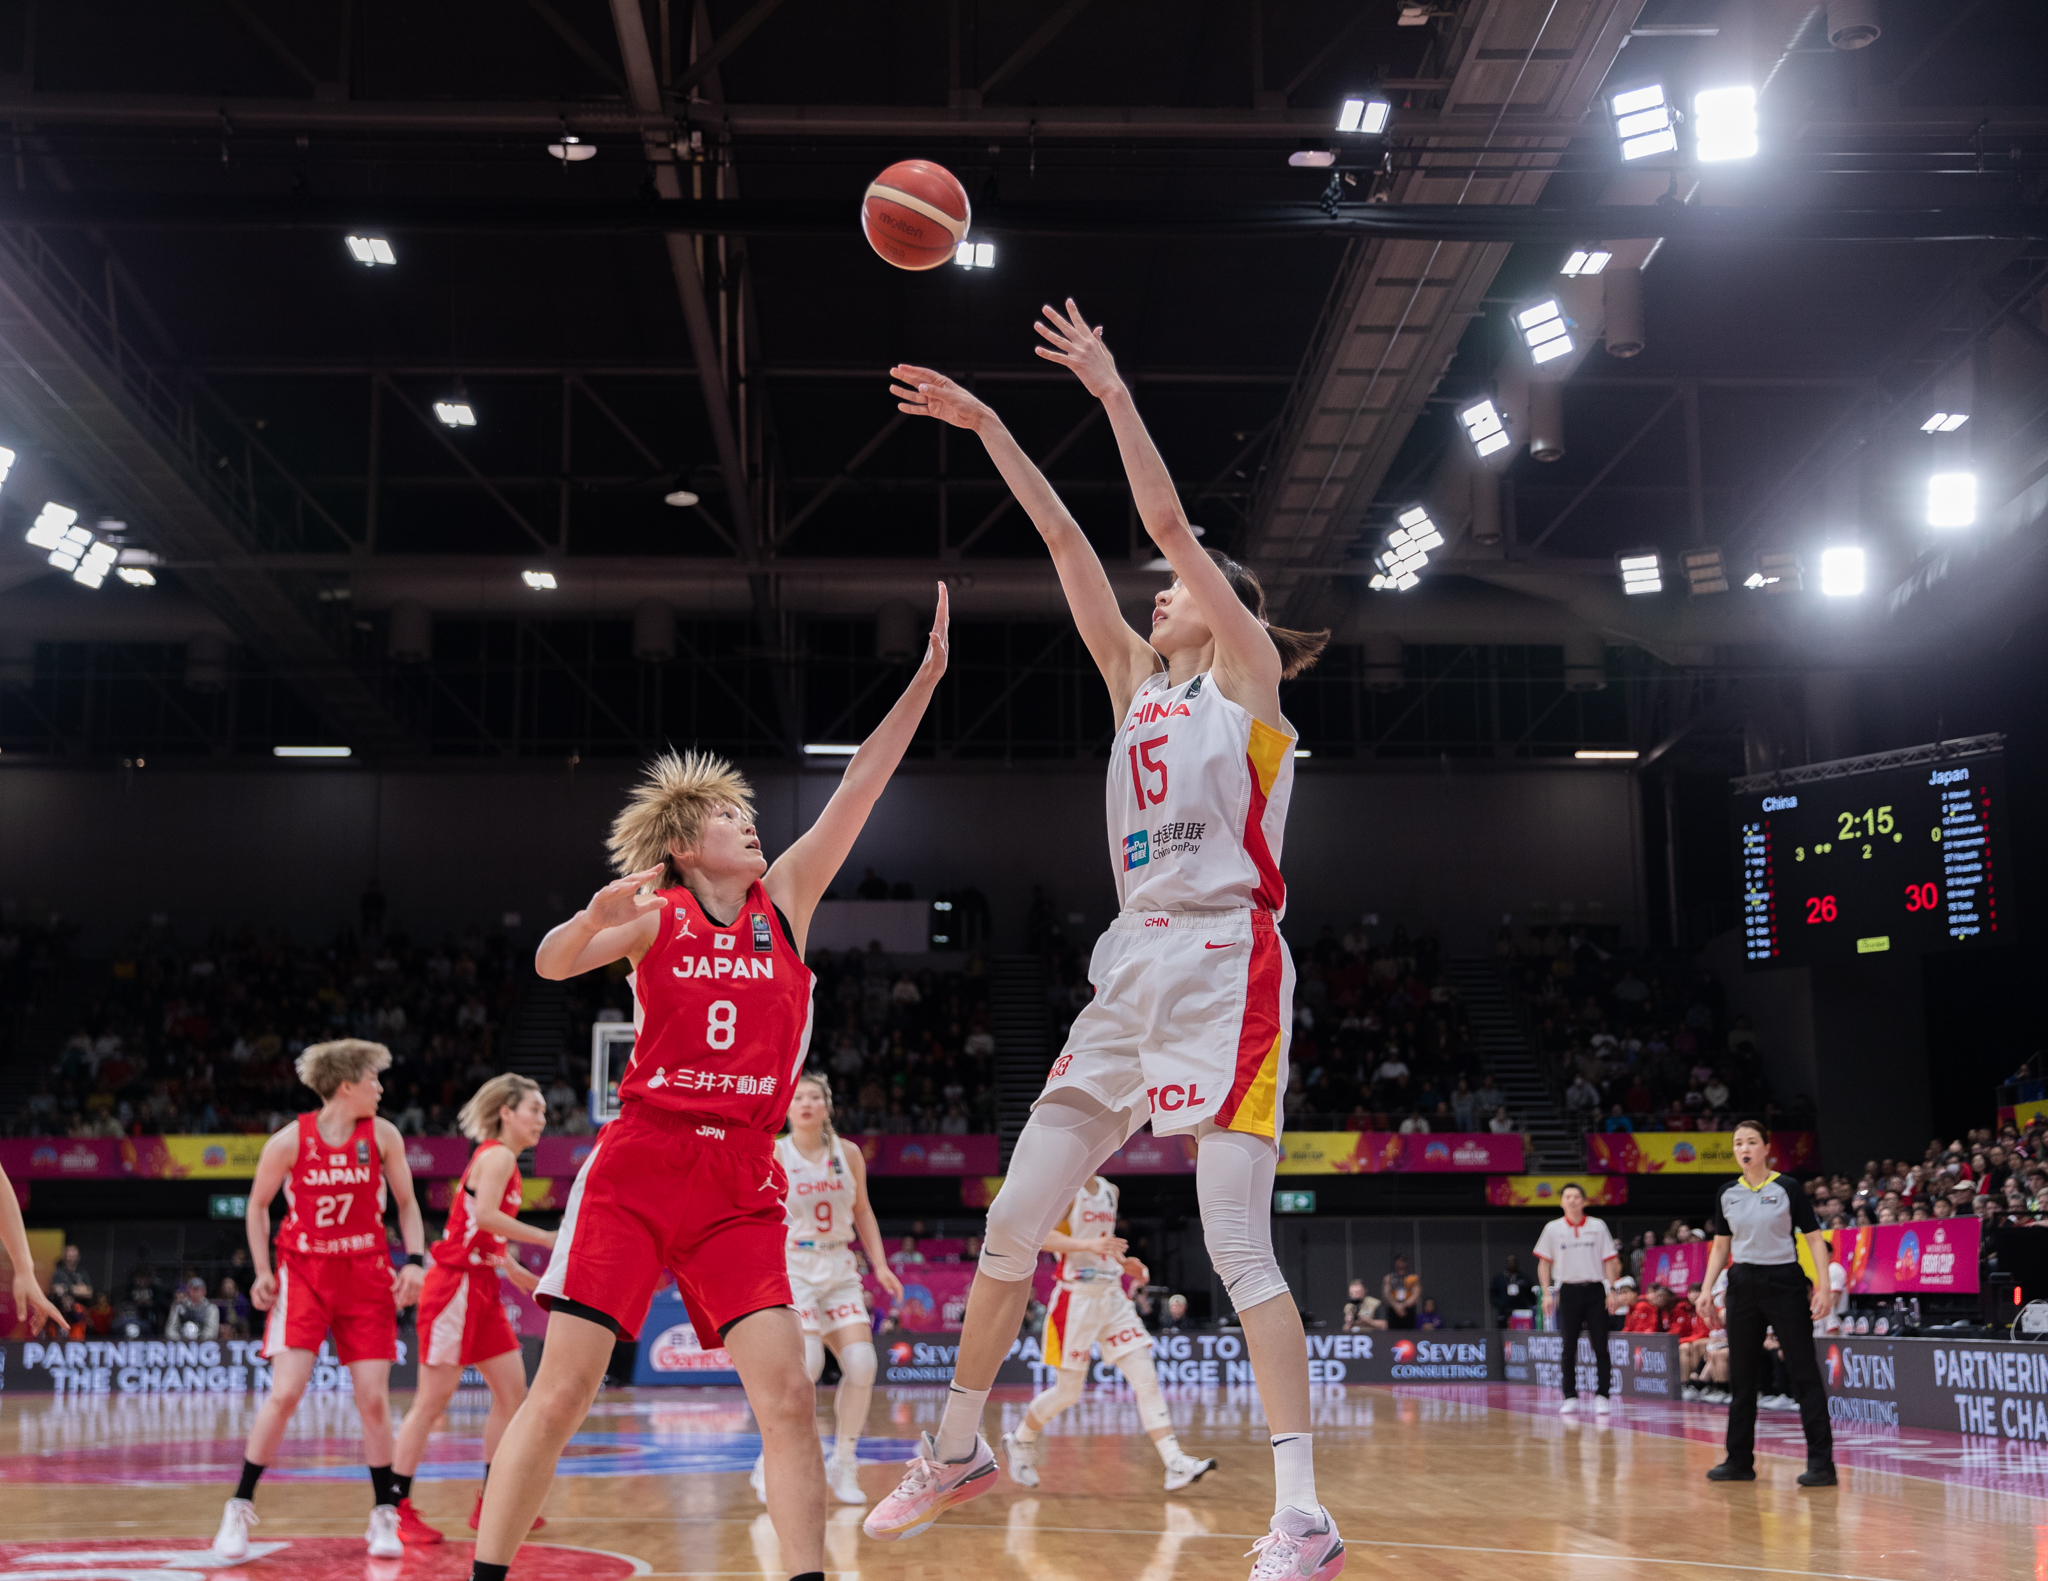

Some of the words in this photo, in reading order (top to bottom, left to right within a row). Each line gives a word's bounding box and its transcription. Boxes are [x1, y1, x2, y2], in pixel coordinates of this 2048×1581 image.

[879, 212, 924, 239] molten
[1128, 734, 1168, 811] 15
[1928, 767, 1970, 787] Japan
[1762, 795, 1798, 812] China
[1837, 805, 1894, 841] 2:15
[1795, 846, 1805, 862] 3
[1862, 843, 1873, 860] 2
[1904, 882, 1938, 912] 30
[1144, 917, 1170, 928] CHN
[1805, 895, 1838, 925] 26
[672, 956, 774, 979] JAPAN
[706, 1000, 737, 1050] 8
[673, 1069, 777, 1096] 三井不動産
[1147, 1083, 1206, 1114] TCL
[696, 1125, 725, 1140] JPN
[303, 1167, 370, 1186] JAPAN
[796, 1180, 844, 1196] CHINA
[315, 1193, 354, 1228] 27
[815, 1201, 833, 1233] 9
[826, 1303, 862, 1321] TCL
[1107, 1327, 1144, 1347] TCL
[1196, 1335, 1241, 1360] TO
[23, 1341, 221, 1369] PARTNERING
[913, 1343, 960, 1365] SEV
[1417, 1341, 1486, 1362] SEVEN
[50, 1367, 111, 1392] THE
[117, 1366, 248, 1392] CHANGE
[1093, 1360, 1220, 1383] CNGE
[1391, 1365, 1488, 1379] CONSULTING
[1843, 1347, 1895, 1390] SEVEN
[1828, 1396, 1899, 1425] CONSULTING
[1954, 1393, 1998, 1434] THE
